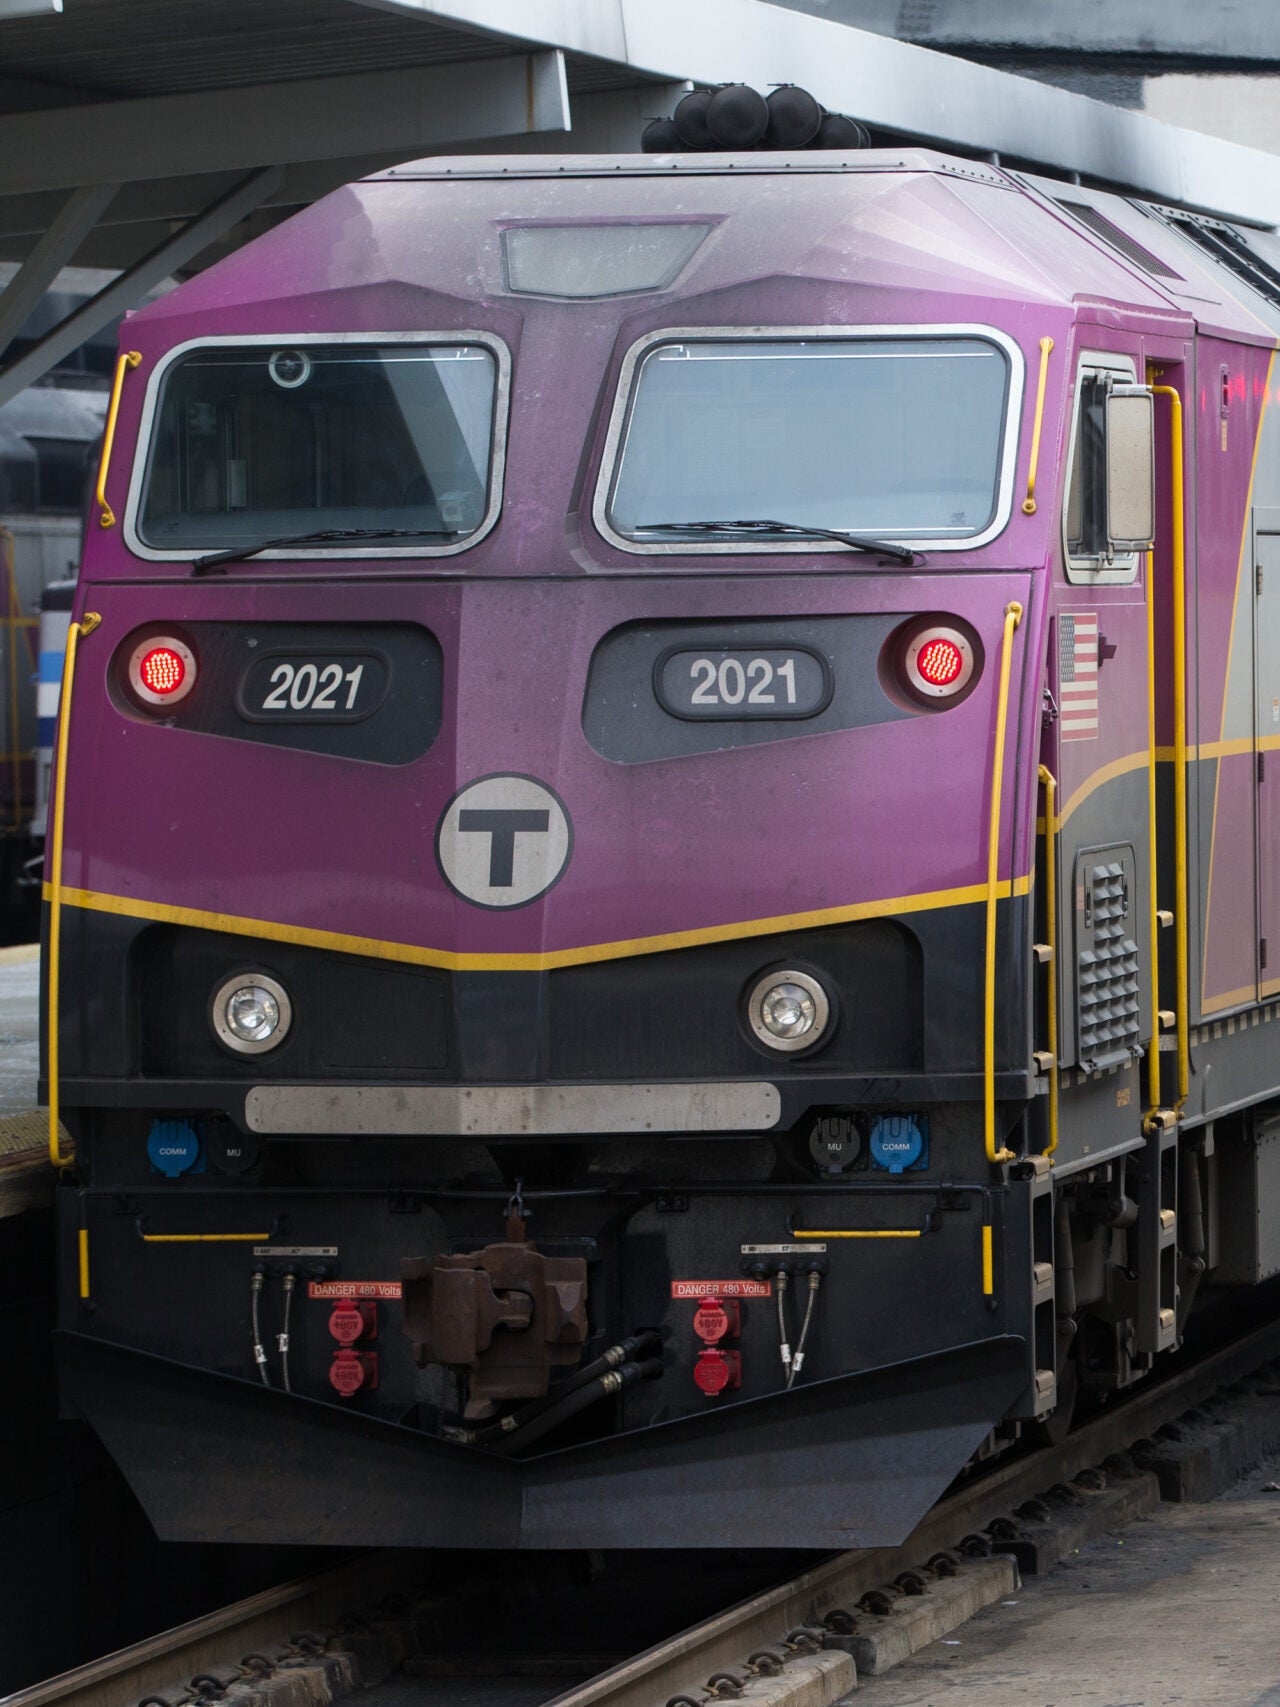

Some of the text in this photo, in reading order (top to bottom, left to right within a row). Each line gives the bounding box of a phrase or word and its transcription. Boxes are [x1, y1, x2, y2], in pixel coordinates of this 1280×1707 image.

[690, 658, 797, 704] 2021
[262, 663, 365, 711] 2021
[458, 808, 550, 888] T
[158, 1147, 187, 1156] COMM
[226, 1148, 242, 1157] MU
[826, 1143, 842, 1151] MU
[882, 1143, 910, 1151] COMM
[314, 1285, 402, 1296] DANGER 480 Volts
[677, 1284, 766, 1295] DANGER 480 Volts
